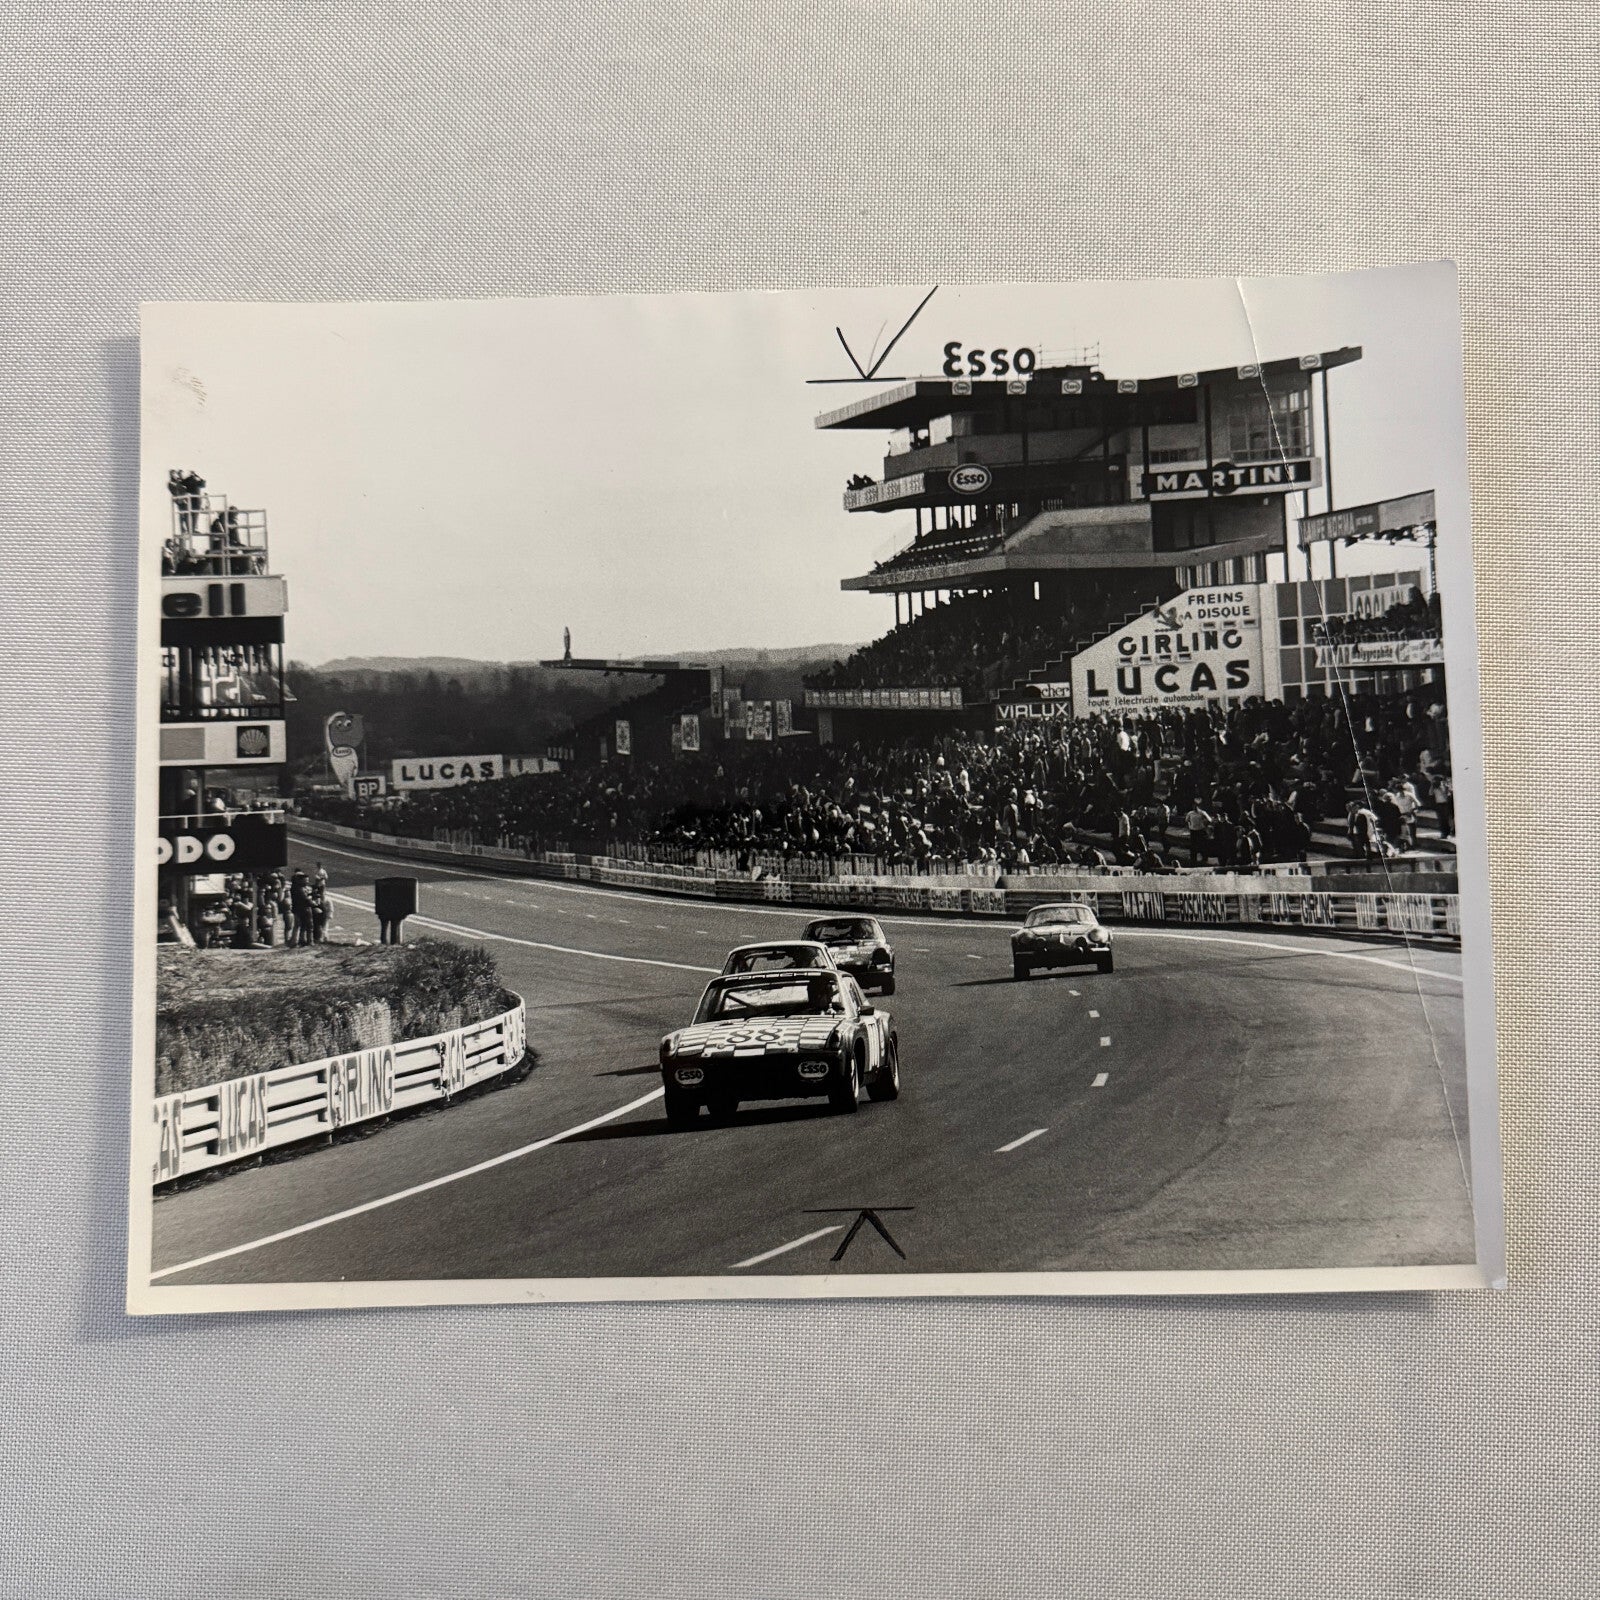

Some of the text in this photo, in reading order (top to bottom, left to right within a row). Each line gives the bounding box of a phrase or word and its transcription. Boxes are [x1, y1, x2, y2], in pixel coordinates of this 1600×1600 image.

[943, 342, 1035, 377] Esso
[956, 472, 985, 485] Esso
[1157, 465, 1296, 491] MARTINI
[1188, 592, 1244, 605] FREINS
[1198, 606, 1250, 619] DISQUE
[1118, 629, 1242, 656] GIRLING
[1087, 659, 1250, 698] LUCAS
[998, 703, 1069, 718] VIRLUX
[1088, 698, 1109, 707] toute
[1163, 693, 1204, 703] automobile
[401, 761, 496, 781] LUCAS
[358, 782, 378, 796] BP
[1122, 891, 1165, 919] MARTINI
[1302, 893, 1334, 925] GIRLING
[726, 1028, 783, 1043] 88
[329, 1048, 393, 1128] GIRLING
[219, 1075, 267, 1157] LUCAS
